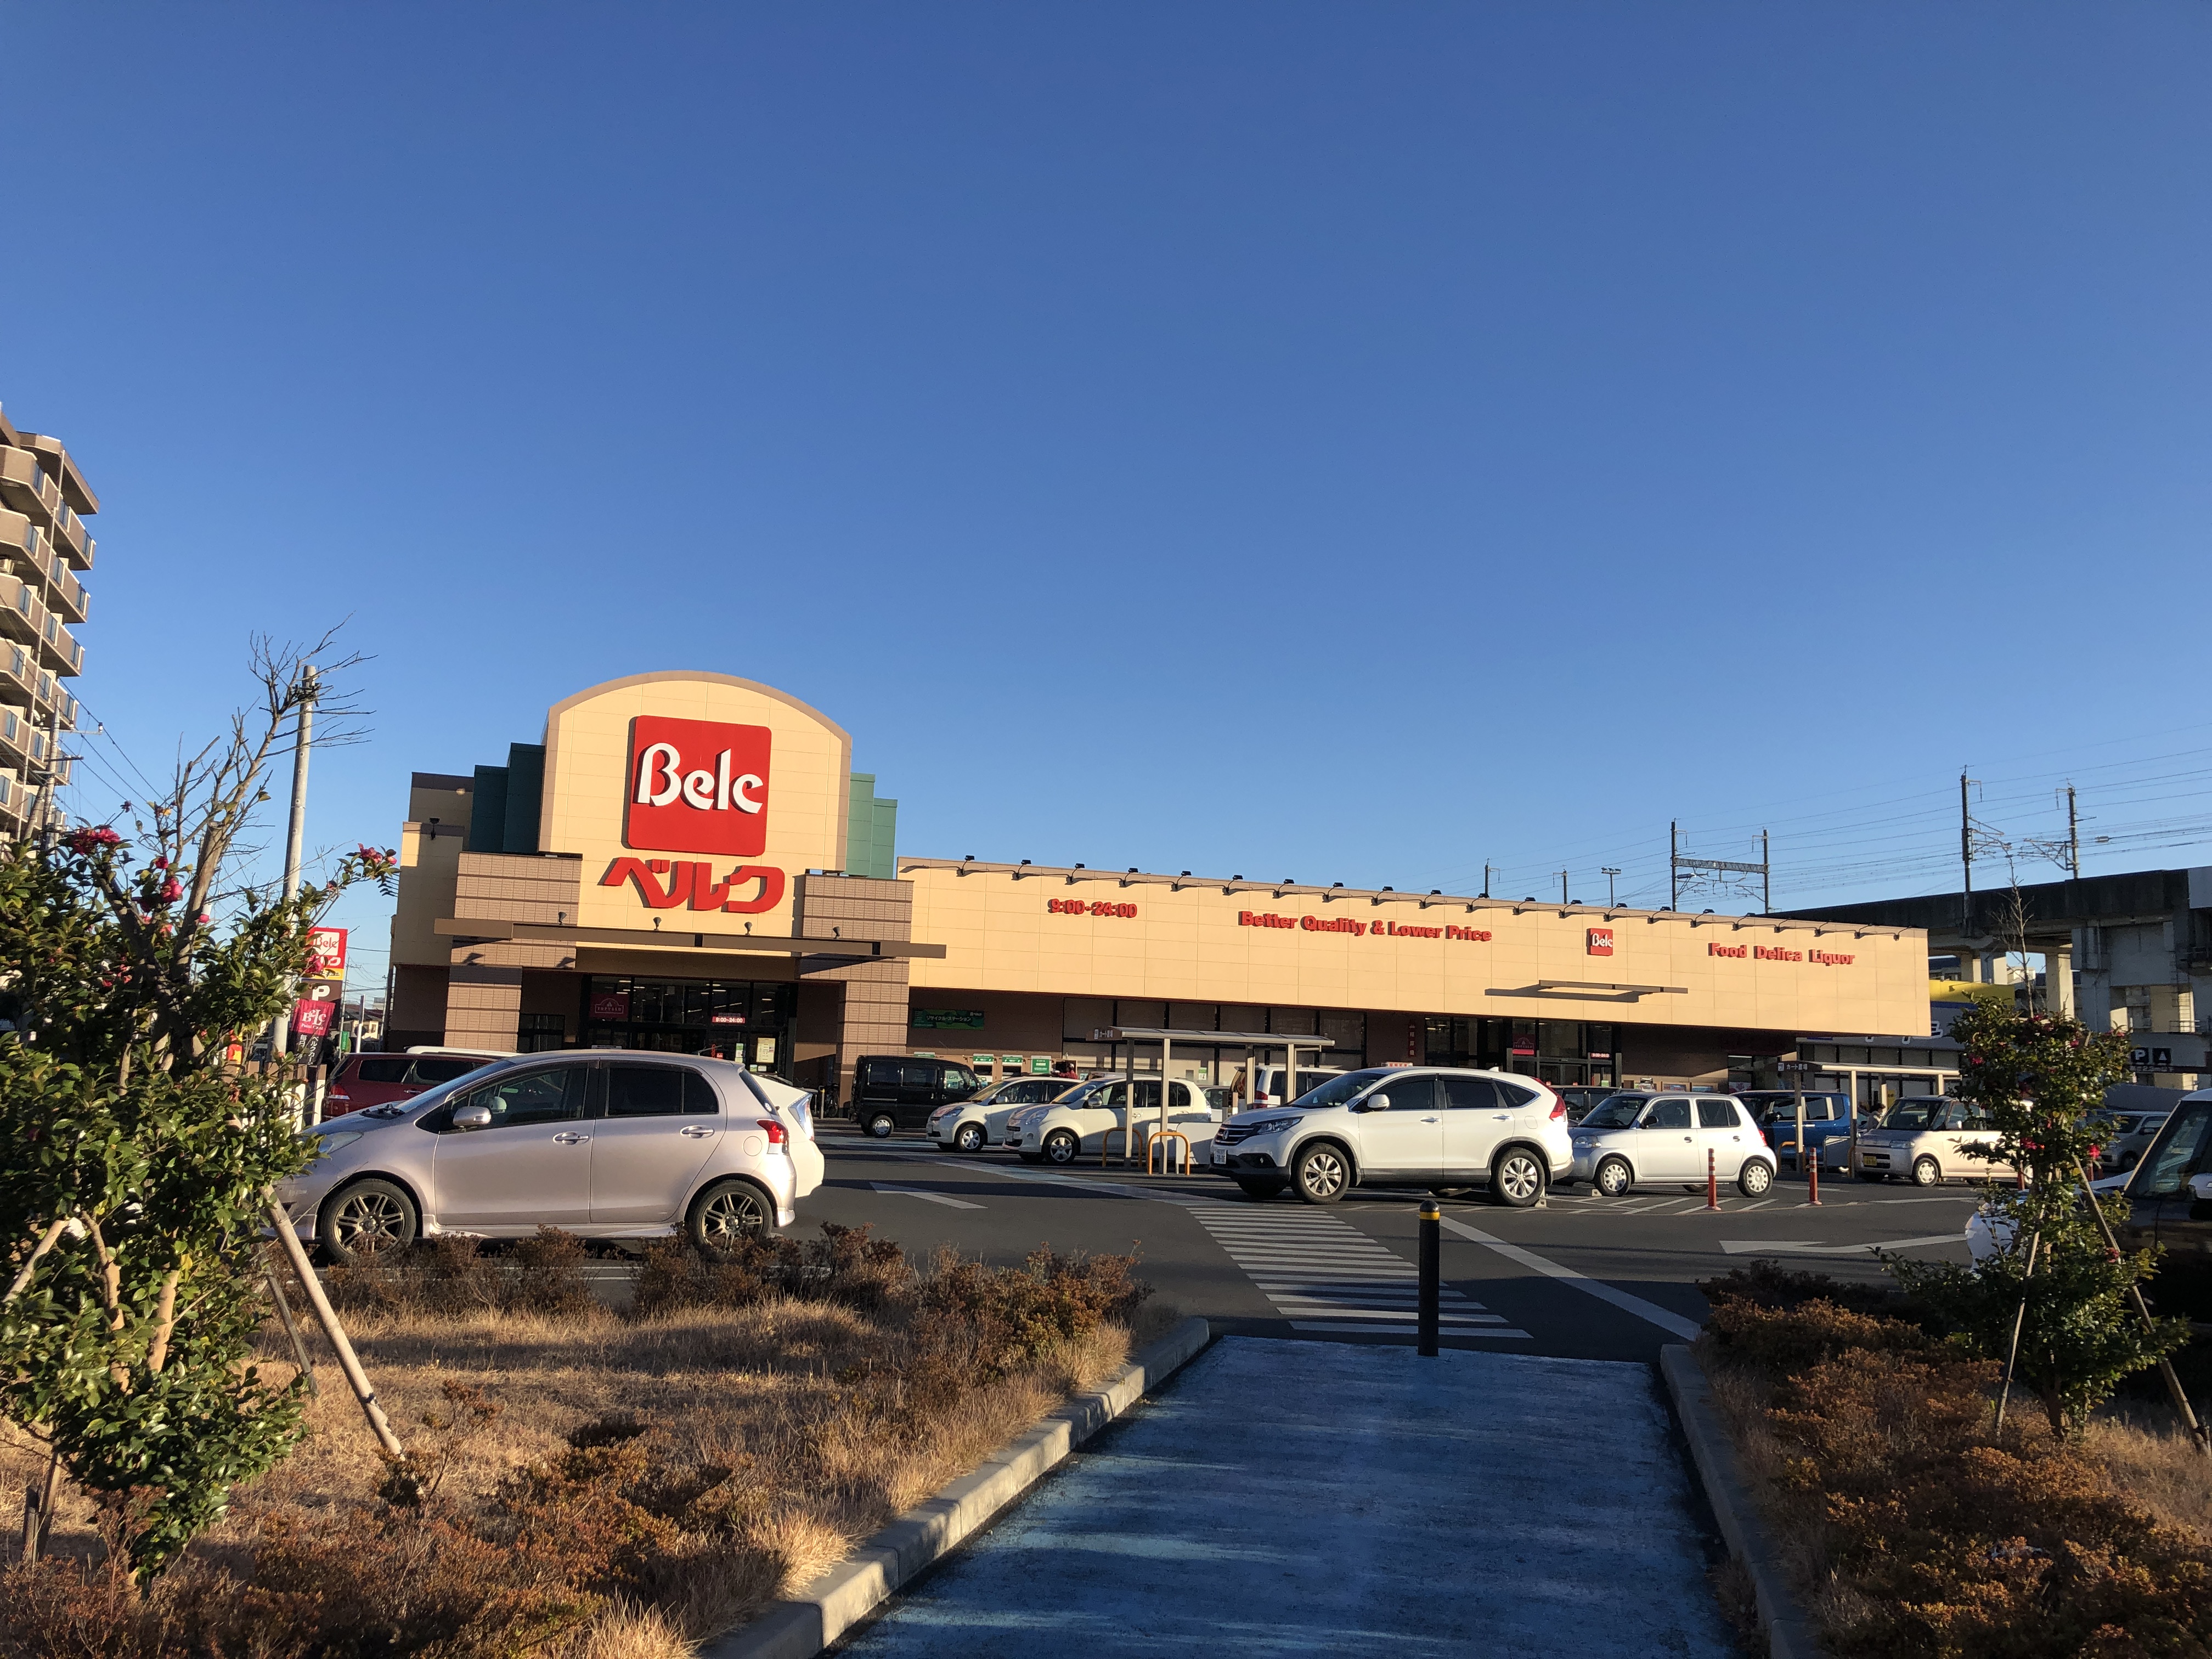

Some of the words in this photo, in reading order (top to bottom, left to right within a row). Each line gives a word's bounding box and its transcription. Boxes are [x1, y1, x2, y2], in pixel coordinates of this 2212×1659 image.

[637, 742, 764, 814] Belc
[603, 856, 786, 914] ベルク
[1240, 911, 1298, 929] Better
[1302, 915, 1367, 936] Quality
[1372, 919, 1385, 935] &
[1389, 921, 1443, 938] Lower
[1447, 925, 1492, 941] Price
[1592, 933, 1613, 947] Belc
[1709, 943, 1747, 958] Food
[1755, 945, 1803, 961] Delica
[1810, 949, 1855, 966] Liquor
[312, 985, 330, 1001] P
[2135, 1049, 2146, 1060] P
